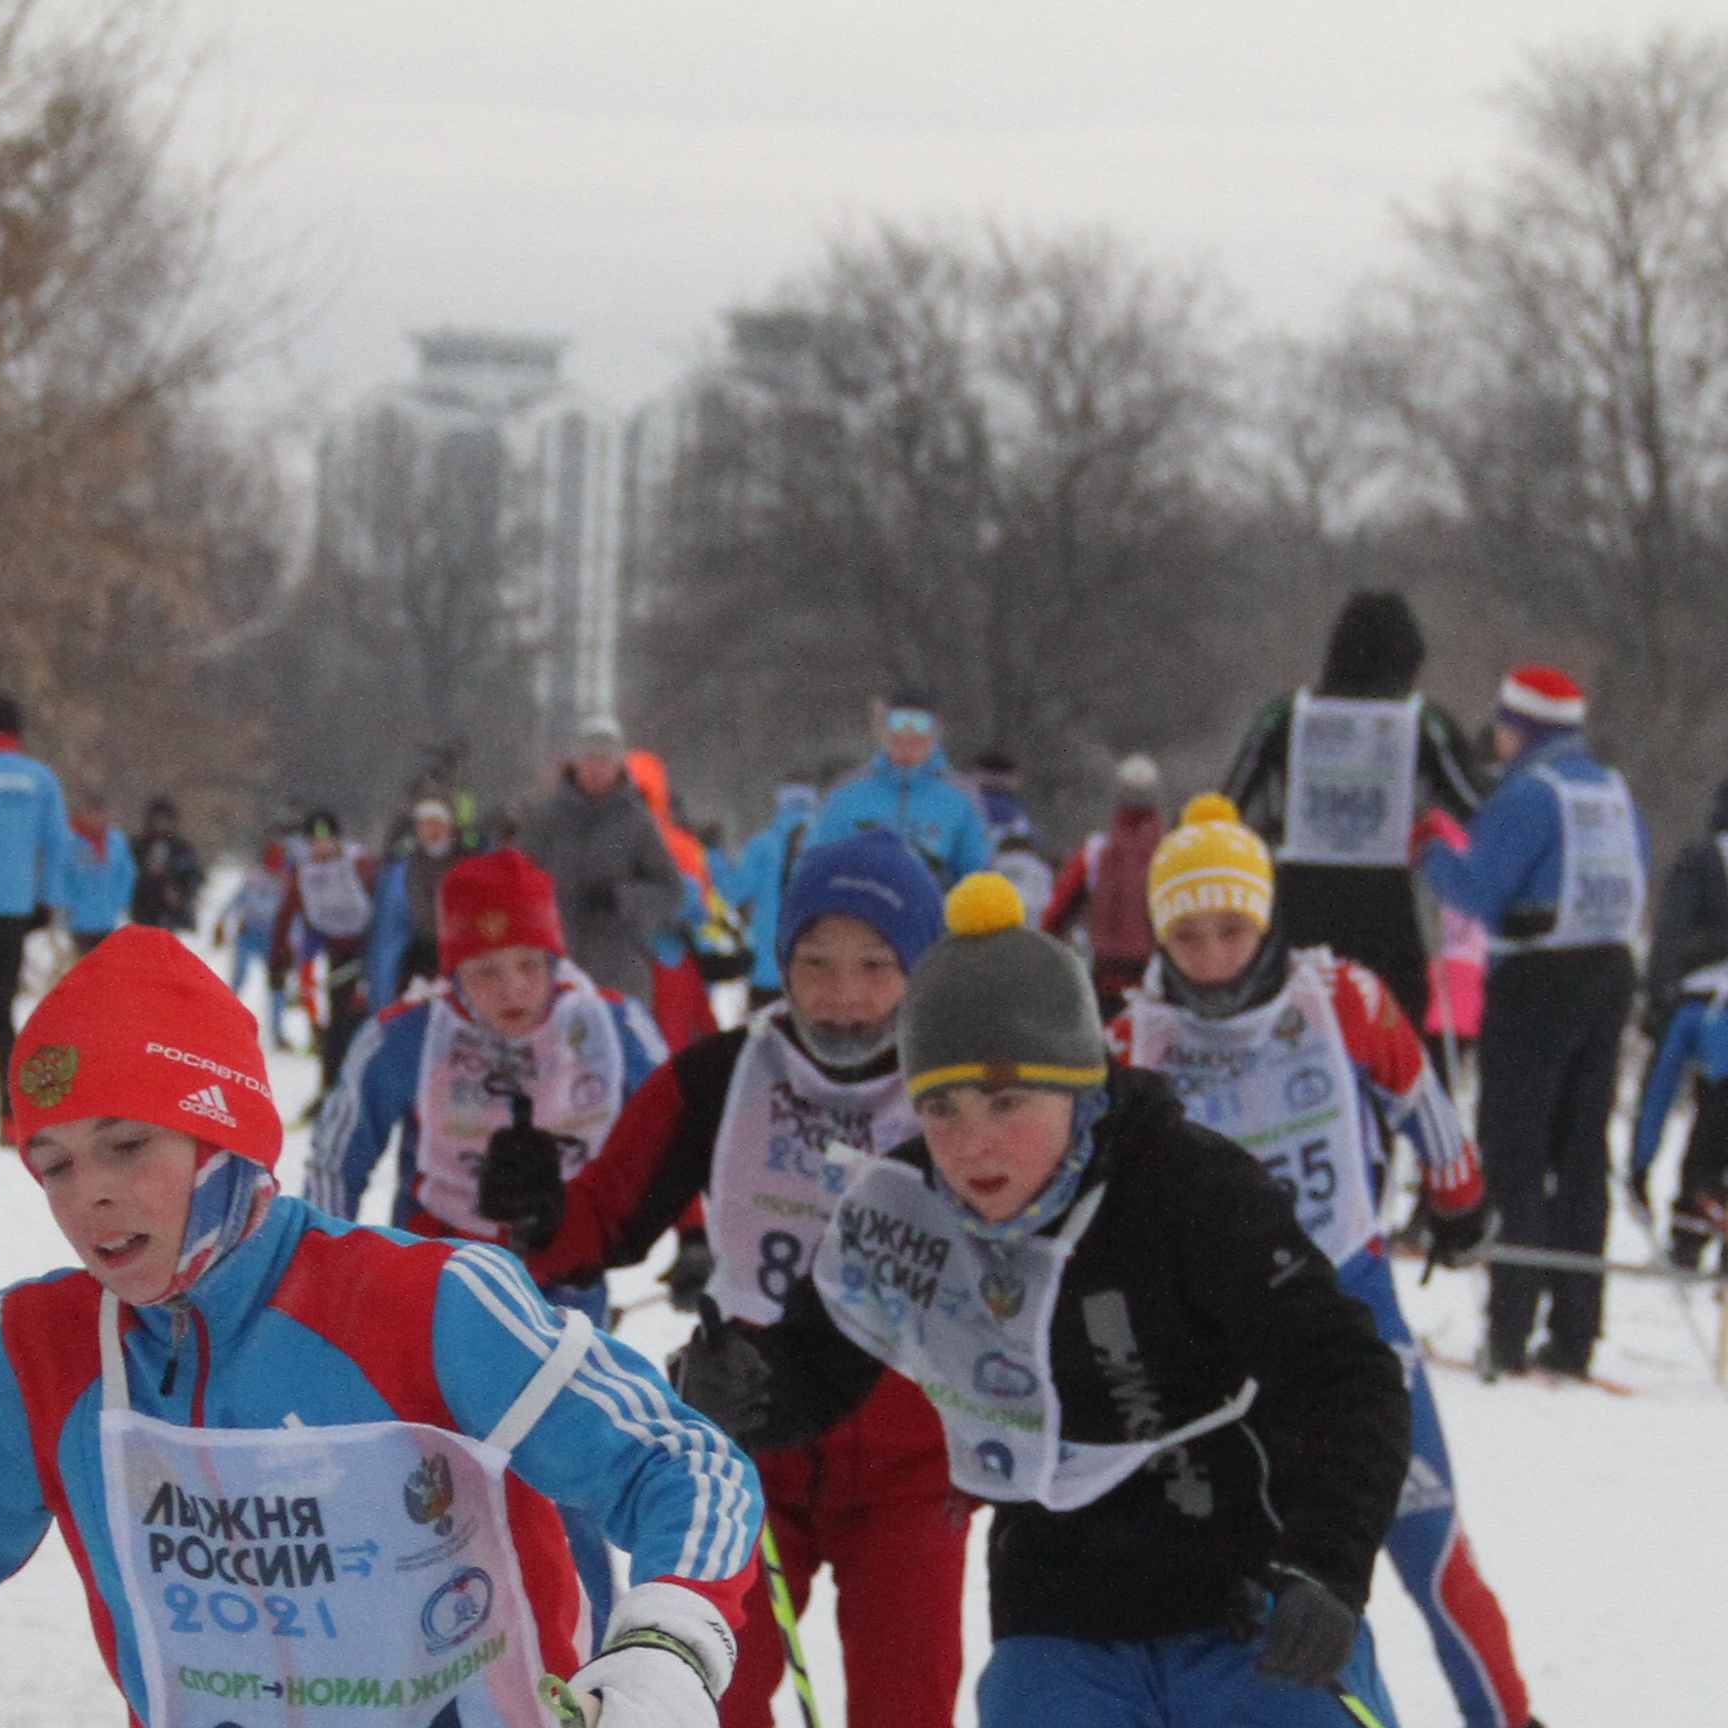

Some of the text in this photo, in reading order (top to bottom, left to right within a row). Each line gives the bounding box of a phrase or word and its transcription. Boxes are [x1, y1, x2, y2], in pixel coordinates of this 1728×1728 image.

[178, 1099, 236, 1128] adidas
[143, 1481, 325, 1541] ЛЫЖНЯ
[149, 1532, 335, 1588] РОССИИ
[163, 1583, 337, 1639] 2021
